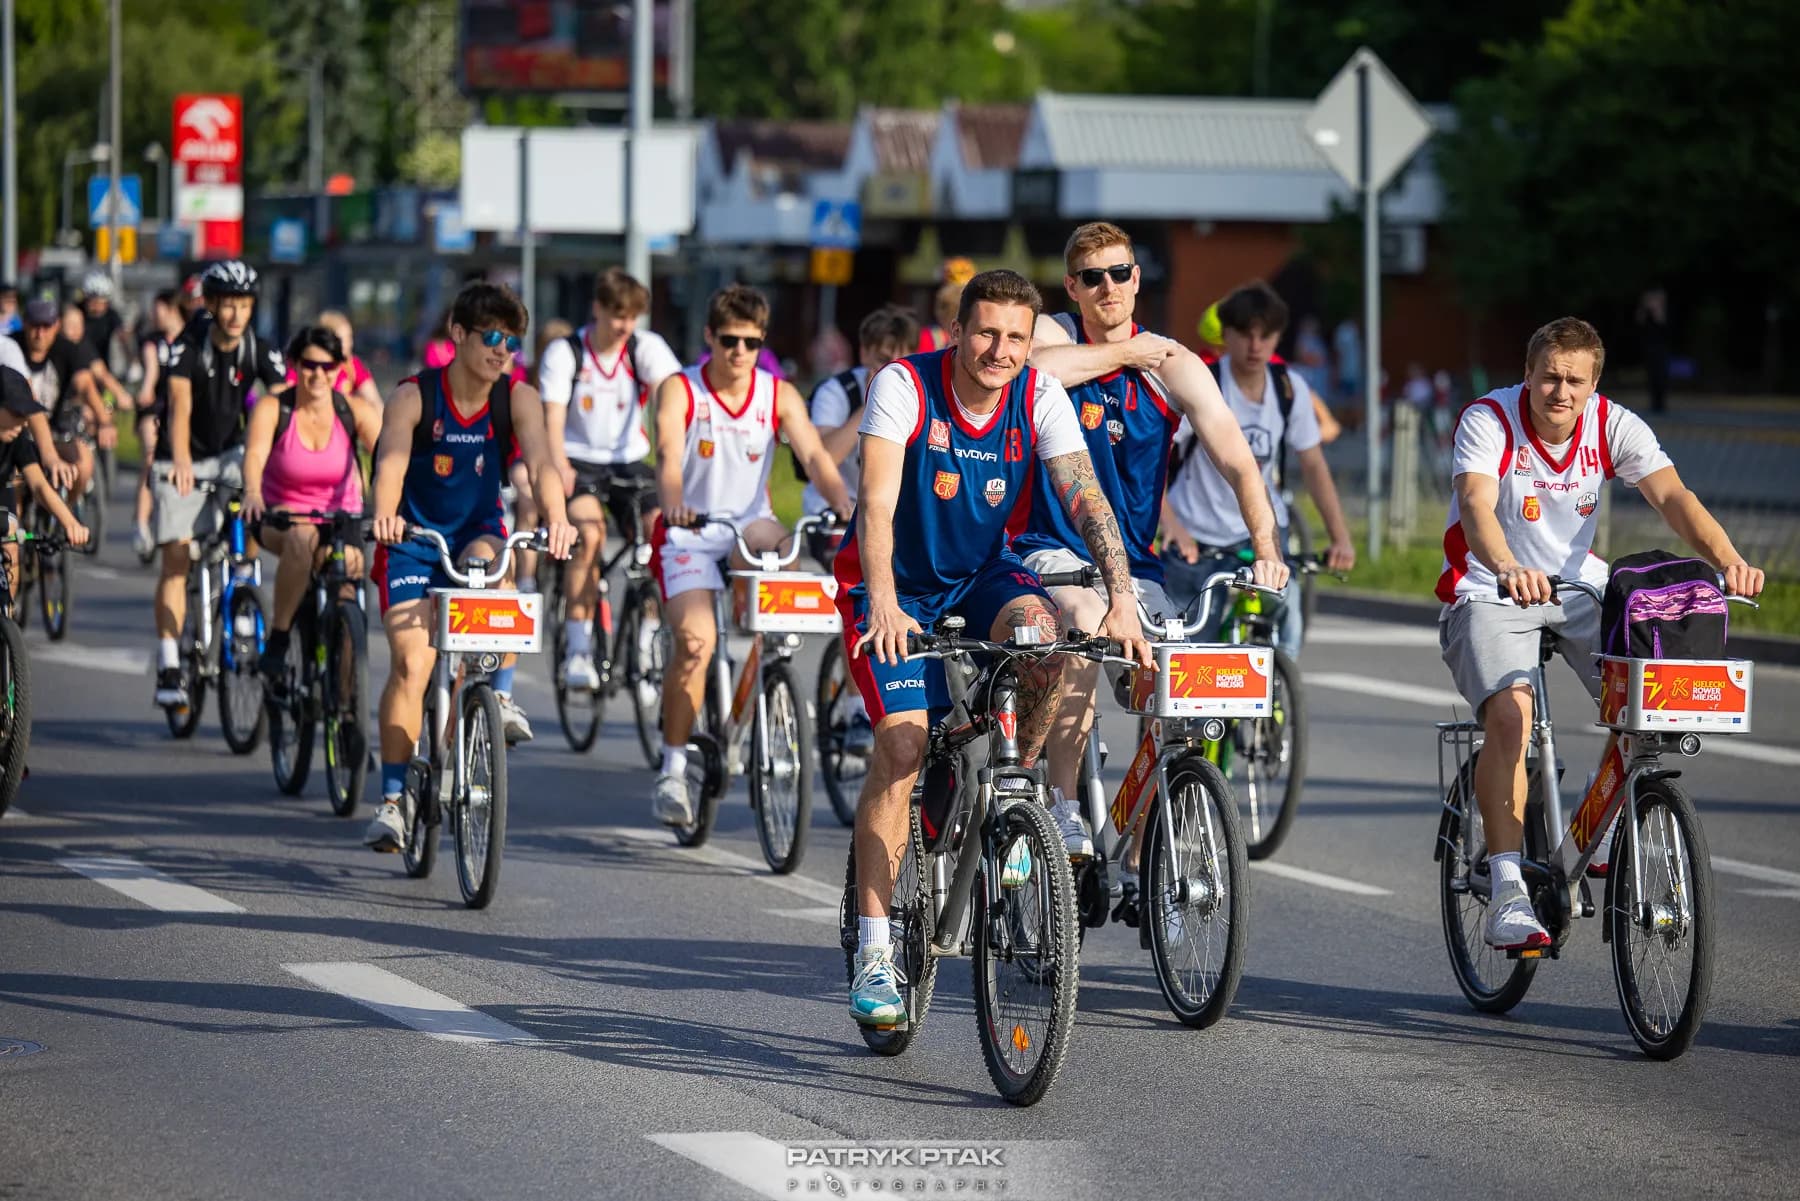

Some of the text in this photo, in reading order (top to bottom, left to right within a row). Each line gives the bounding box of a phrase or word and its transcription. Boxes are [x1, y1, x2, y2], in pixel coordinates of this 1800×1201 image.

[1579, 446, 1599, 477] 14
[935, 482, 952, 498] CK
[1533, 480, 1579, 492] GIVOVA
[1524, 506, 1539, 519] CK
[1692, 680, 1726, 688] KIELECKI
